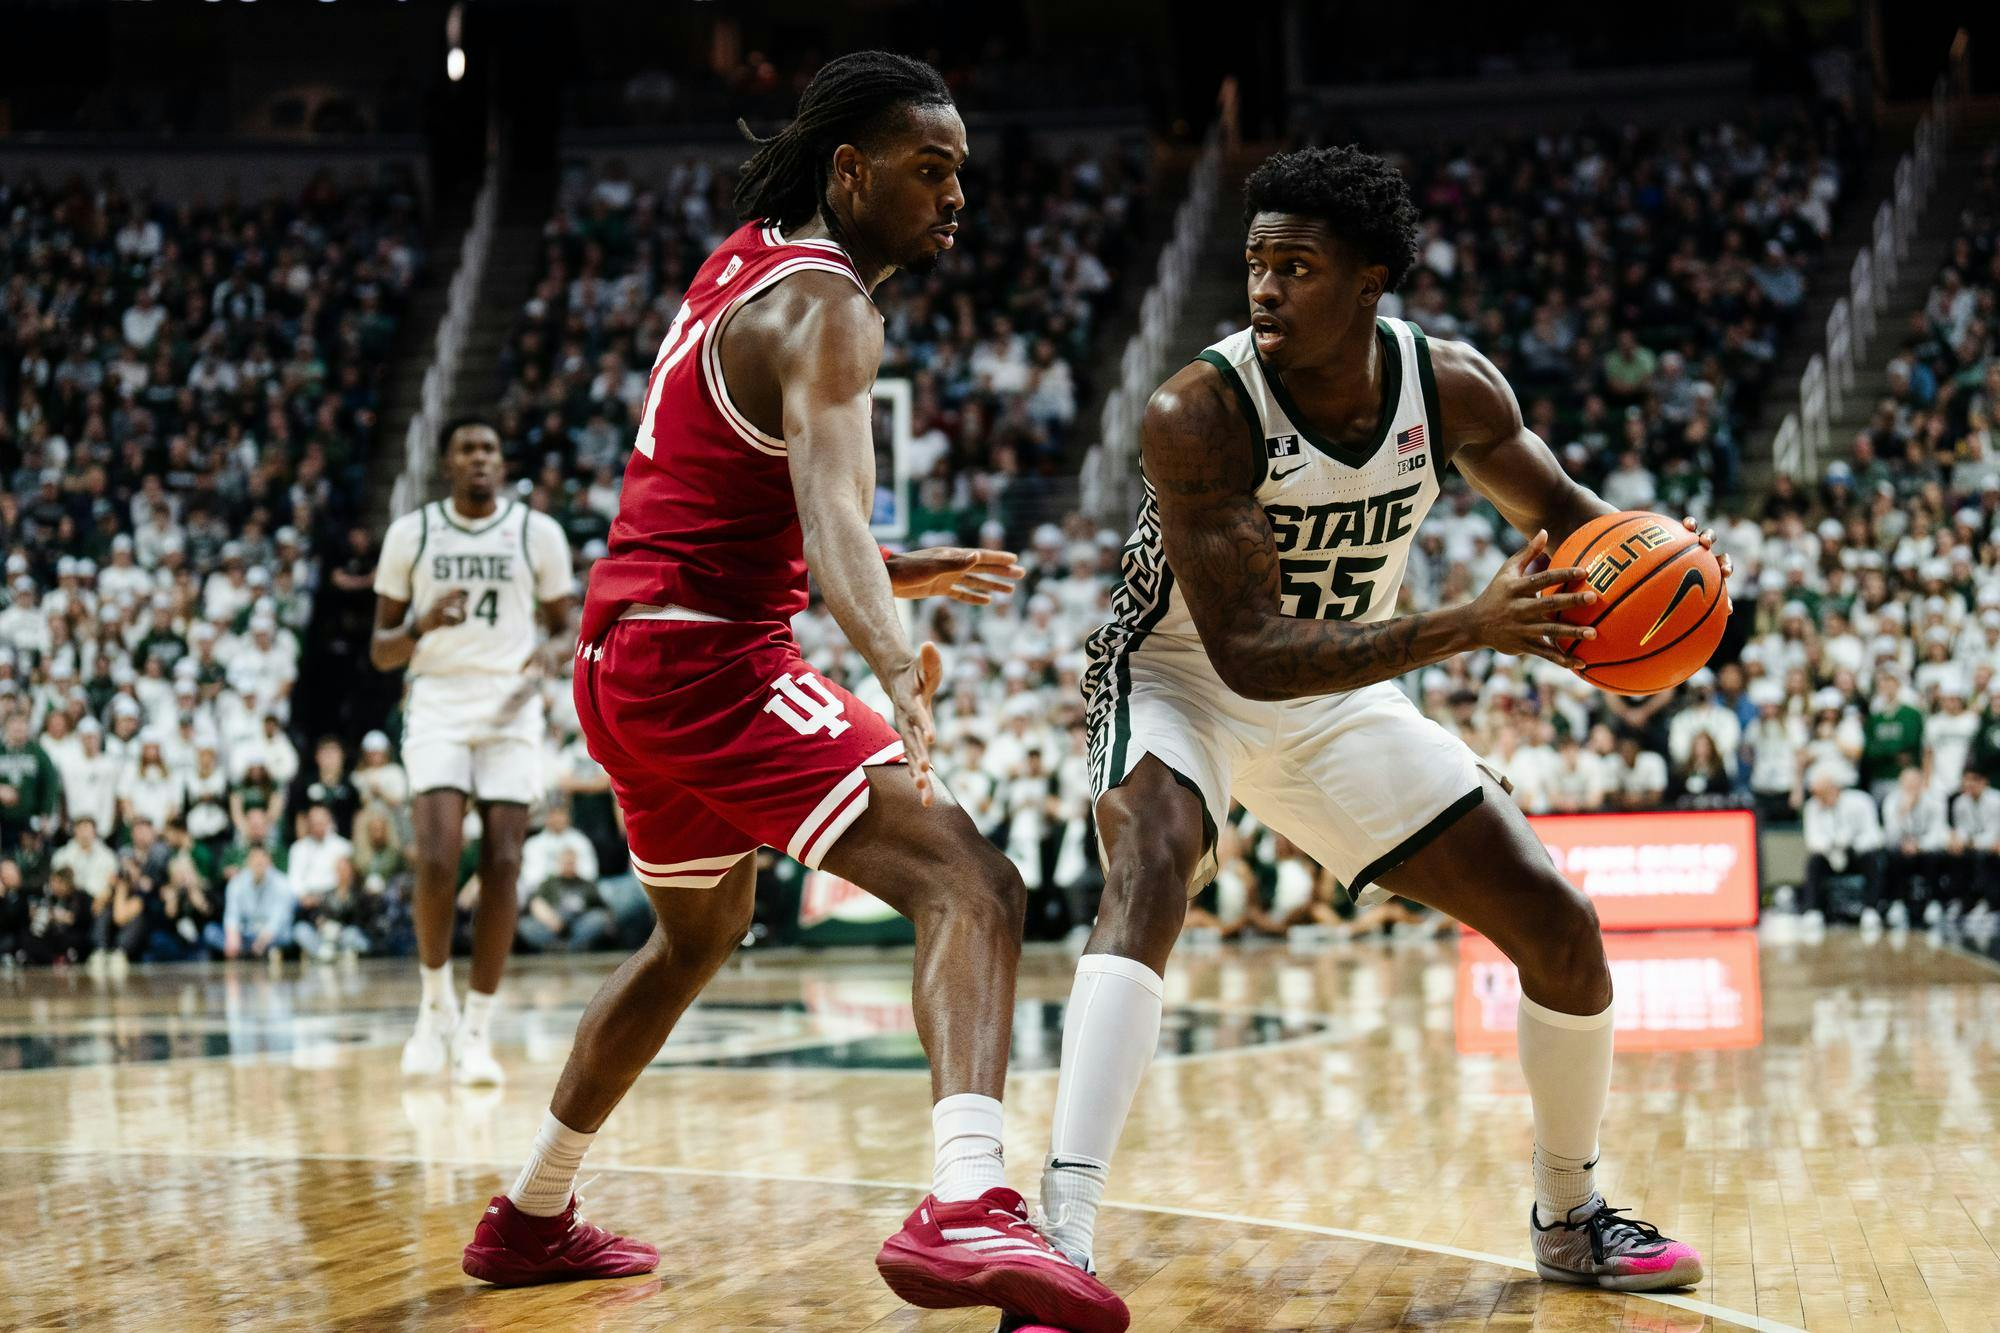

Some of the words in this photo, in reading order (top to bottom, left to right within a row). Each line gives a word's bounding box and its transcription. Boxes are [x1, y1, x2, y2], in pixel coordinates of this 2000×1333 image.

[1274, 436, 1292, 457] JF
[1263, 481, 1423, 552] STATE
[432, 553, 515, 581] STATE
[1279, 555, 1388, 622] 55
[1586, 523, 1676, 595] ELITE
